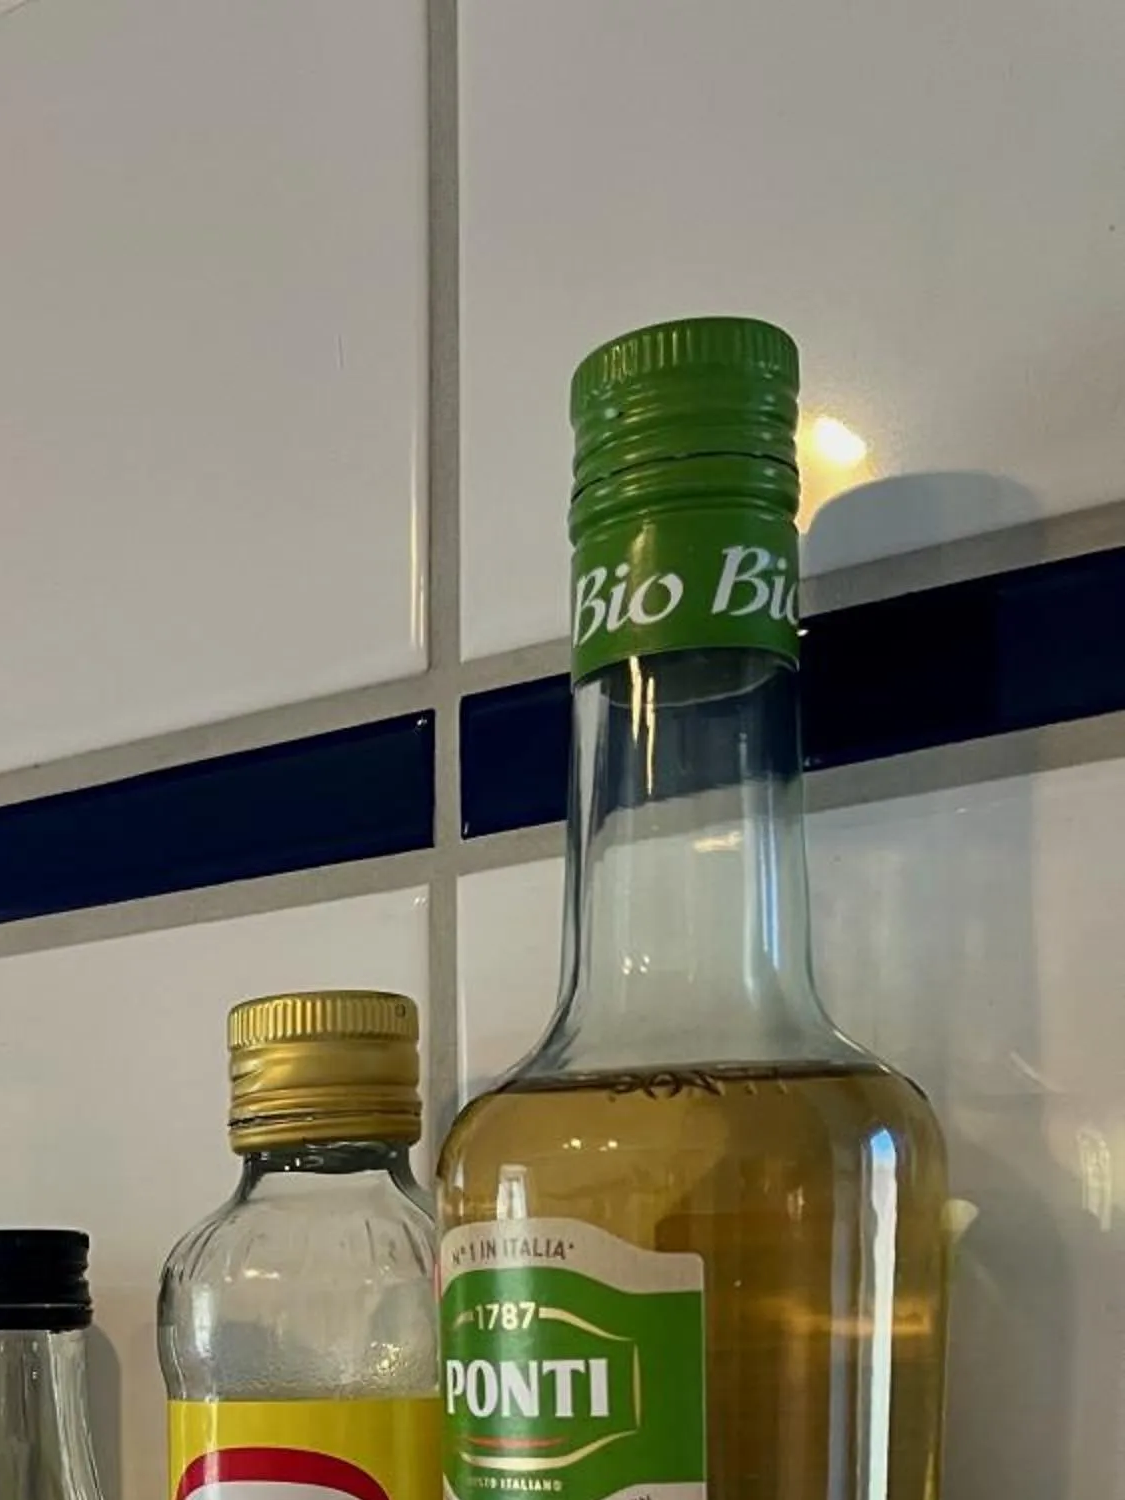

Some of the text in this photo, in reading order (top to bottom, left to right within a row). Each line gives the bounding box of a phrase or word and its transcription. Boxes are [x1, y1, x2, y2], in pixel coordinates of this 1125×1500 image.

[571, 561, 684, 649] Bio
[475, 1301, 536, 1330] 1787
[446, 1357, 610, 1418] PONTI
